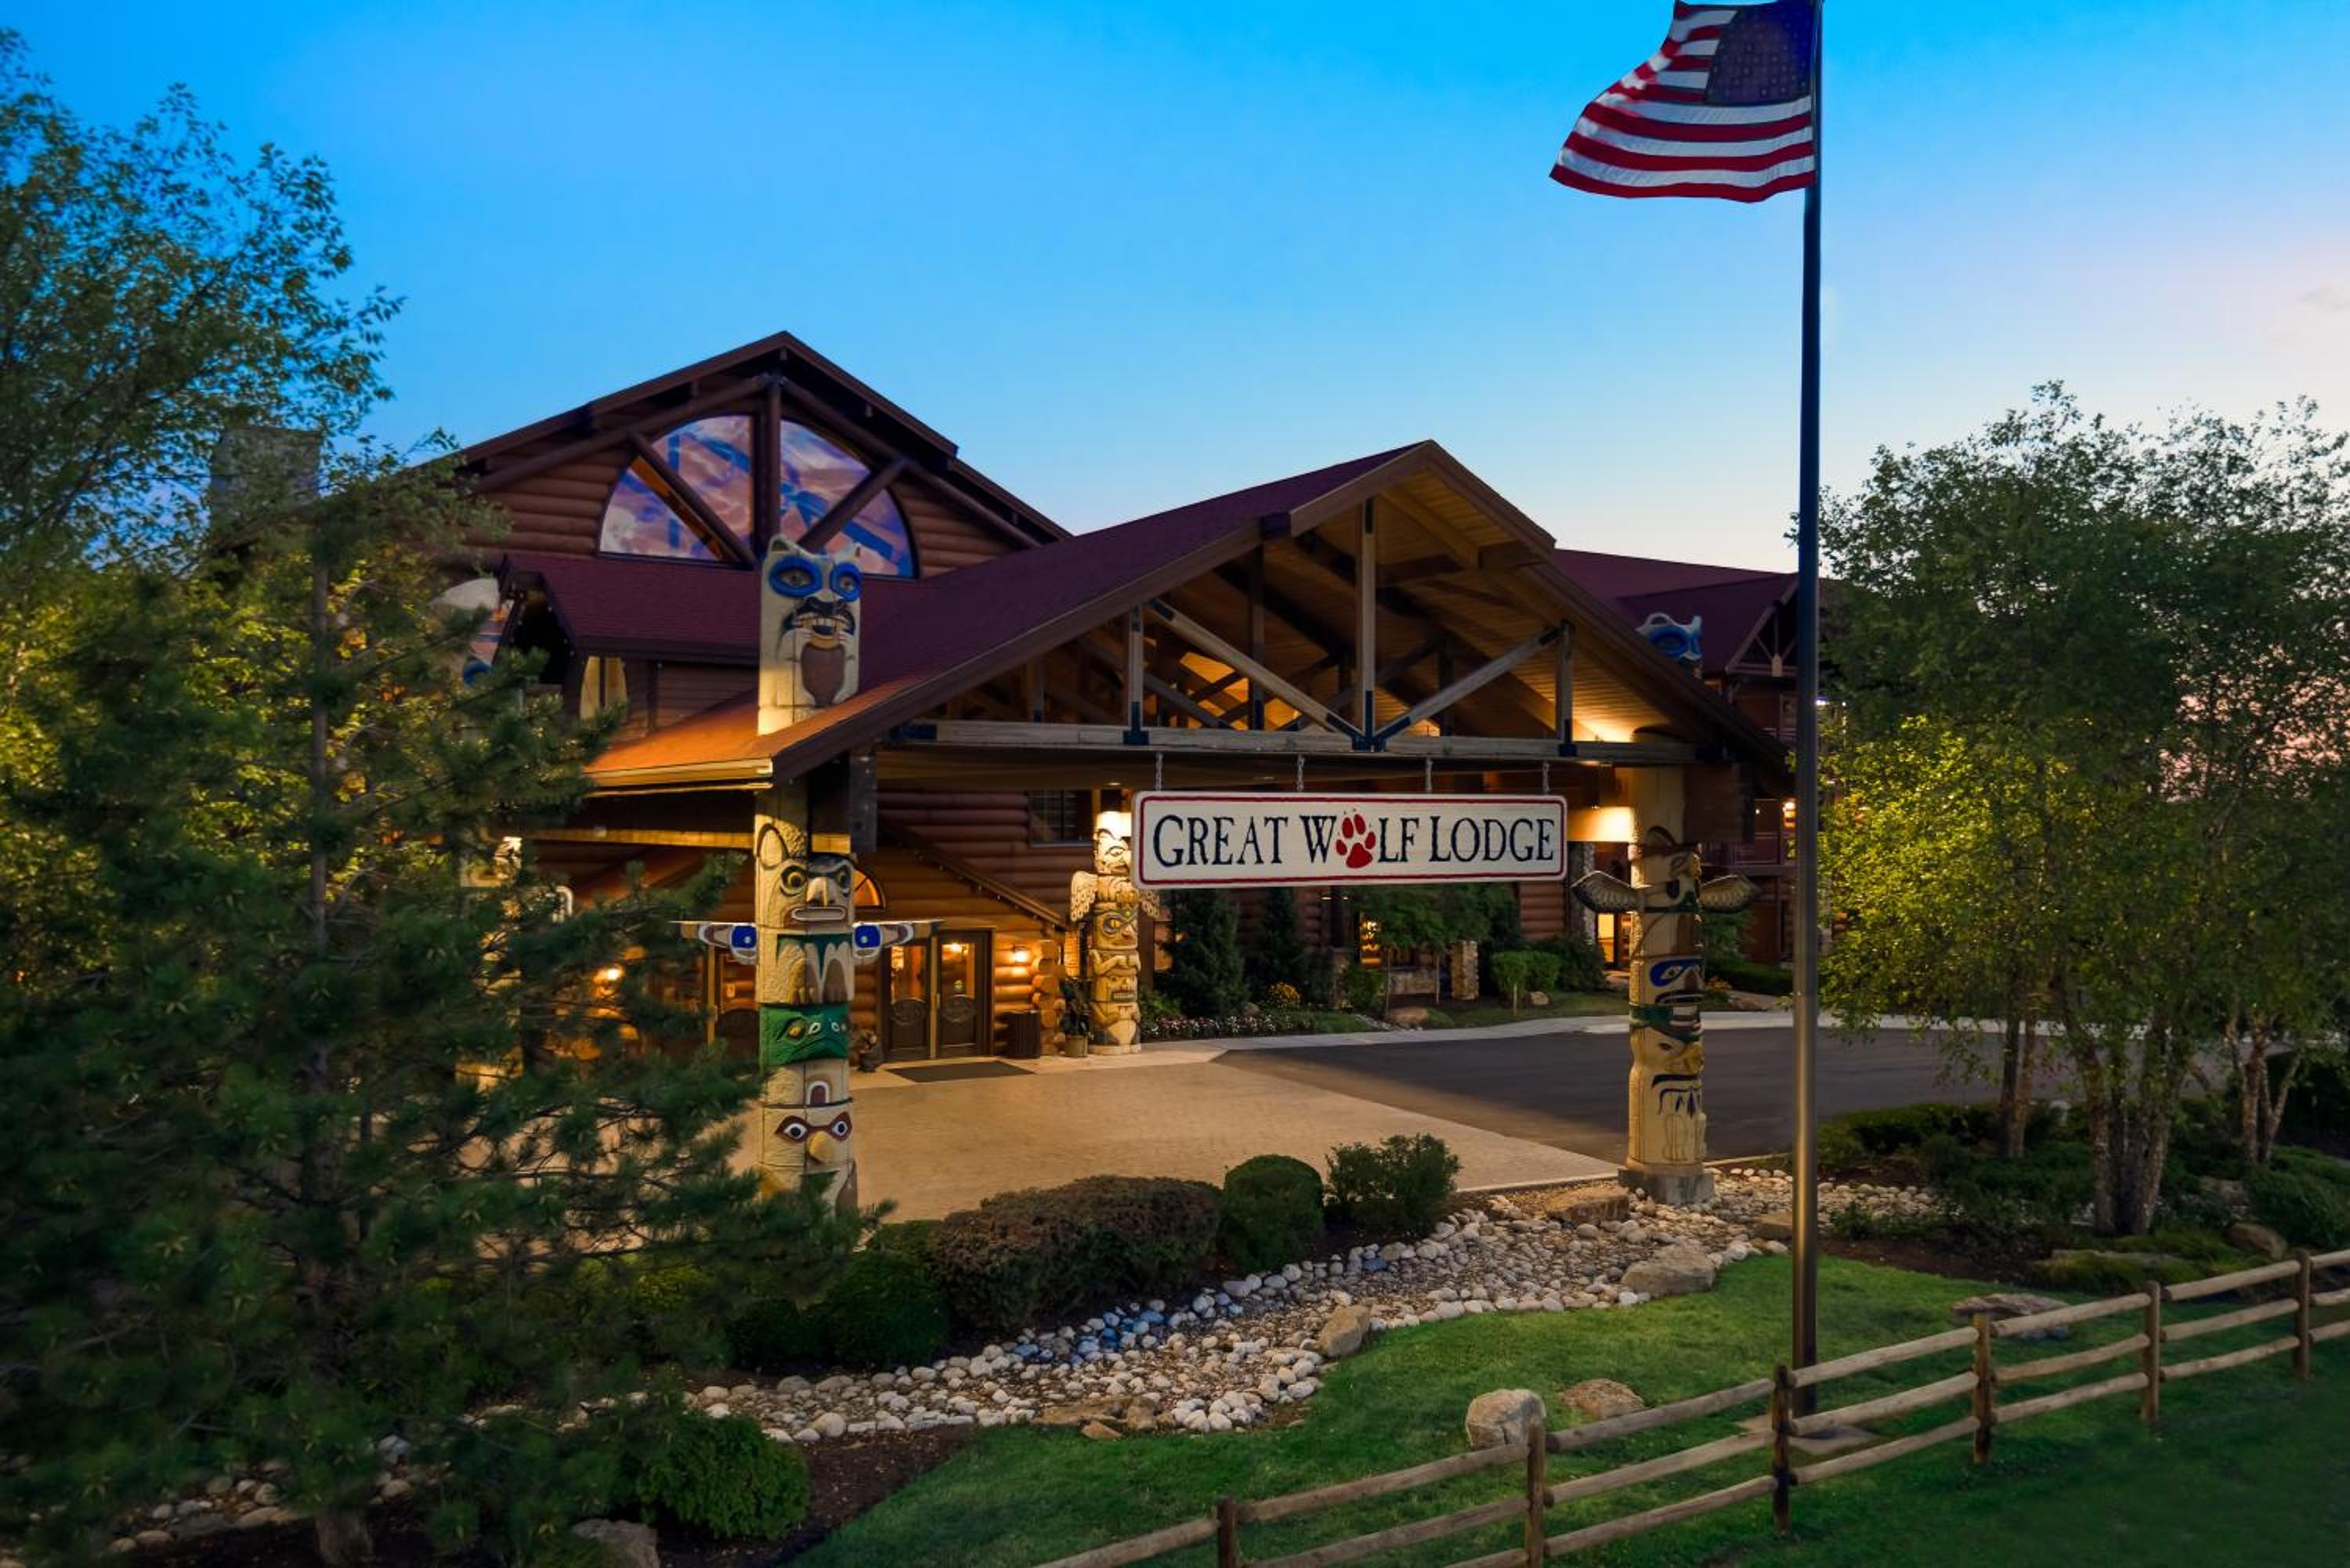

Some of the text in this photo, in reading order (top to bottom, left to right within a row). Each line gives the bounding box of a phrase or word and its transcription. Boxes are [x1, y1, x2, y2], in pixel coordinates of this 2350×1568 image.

[1152, 811, 1556, 869] GREAT WLF LODGE
